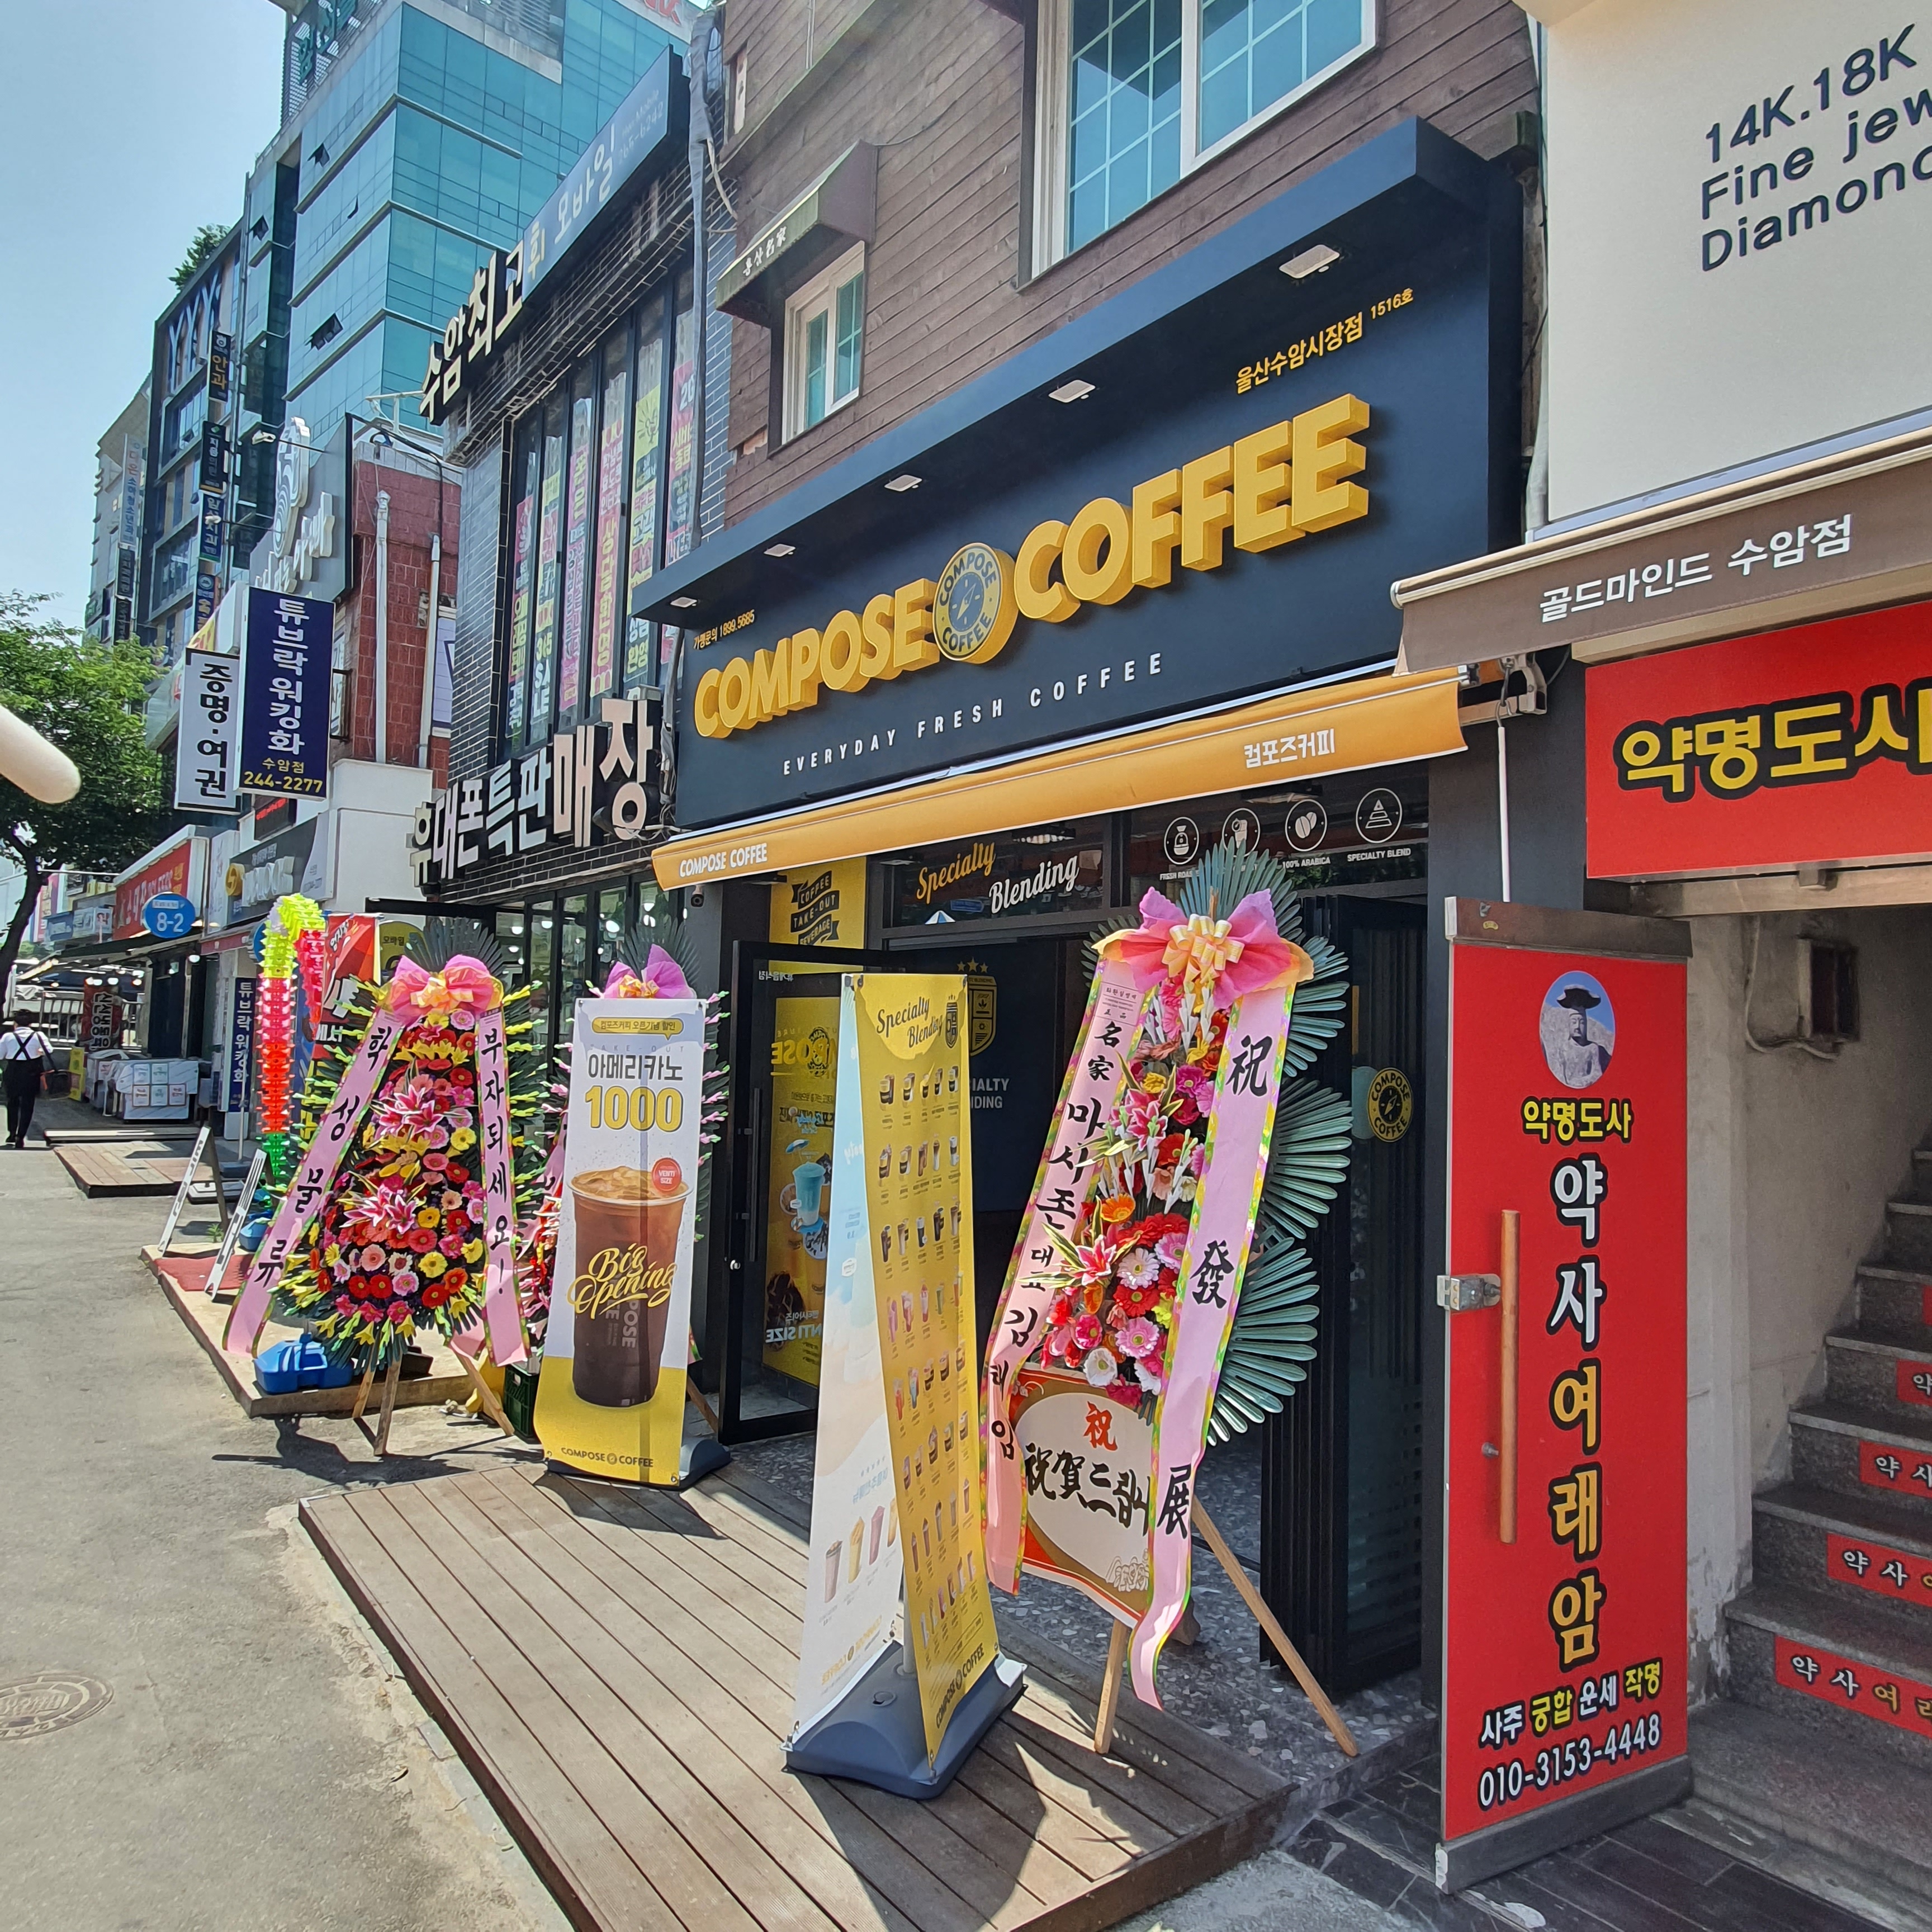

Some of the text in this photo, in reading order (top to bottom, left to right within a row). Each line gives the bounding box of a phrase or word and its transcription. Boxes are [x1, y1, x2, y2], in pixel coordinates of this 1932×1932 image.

[1705, 23, 1917, 163] 14K.18K
[555, 123, 615, 245] 모바일
[1701, 146, 1815, 220] Fine
[1236, 288, 1414, 394] 울산수암시장점 1516호
[695, 578, 940, 738] COMPOSE
[1014, 393, 1370, 623] COFFEE
[940, 552, 997, 608] COMPOSE
[1540, 513, 1853, 623] 골드마인드 수암점
[693, 625, 719, 650] 가맹문의
[942, 614, 991, 653] COFFEE
[784, 653, 1161, 776] EVERYDAY FRESH COFFEE
[262, 757, 305, 774] 수암점
[1243, 728, 1336, 769] 컴포즈커피
[243, 771, 323, 793] 244-2277
[679, 842, 768, 878] COMPOSE COFFEE
[1282, 856, 1330, 869] 100% ARABICA
[1347, 847, 1411, 863] SPECIALTY BLEND
[801, 875, 830, 905] COFFEE
[988, 855, 1080, 913] Blending
[157, 912, 184, 933] 8-2
[793, 894, 836, 929] TAKE-OUT
[799, 918, 831, 945] BEVERAGE
[600, 1020, 632, 1030] 컴포즈커피
[632, 1021, 660, 1031] 오픈기념
[907, 1013, 944, 1049] Blending
[588, 1054, 684, 1081] 아메리카노
[1370, 1071, 1411, 1102] COMPOSE
[585, 1085, 684, 1133] 1000
[1372, 1116, 1408, 1138] COFFEE
[1522, 1101, 1632, 1142] 약명도사
[588, 1242, 648, 1283] Big
[566, 1261, 678, 1320] Opening
[1083, 1401, 1119, 1451] 祝
[560, 1447, 654, 1468] COMPOSE COFFEE
[962, 1642, 985, 1677] COFFEE
[1481, 1661, 1663, 1745] 사주 궁합 운세 작명
[1480, 1713, 1661, 1807] 010-3153-4448
